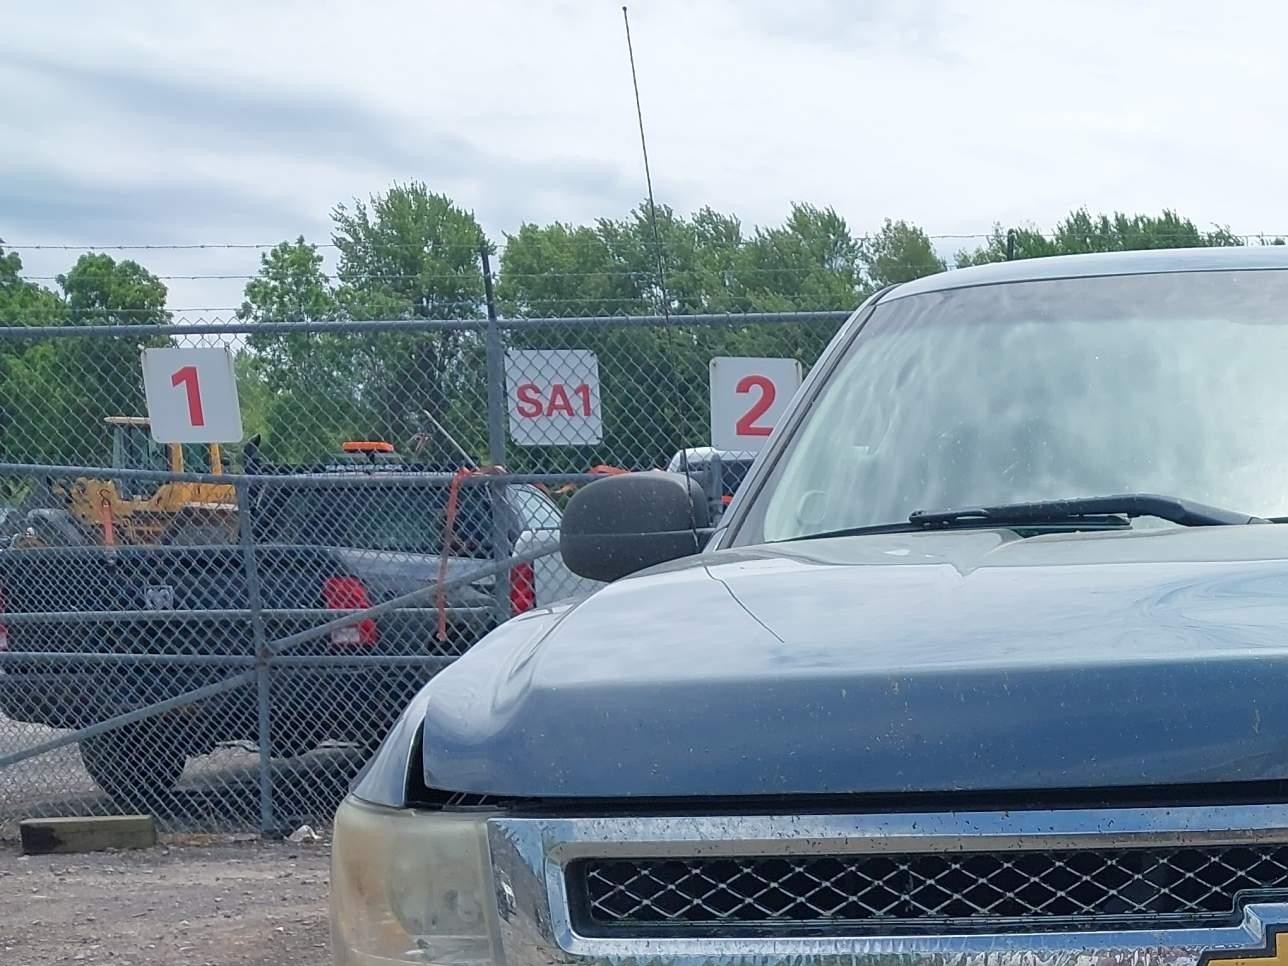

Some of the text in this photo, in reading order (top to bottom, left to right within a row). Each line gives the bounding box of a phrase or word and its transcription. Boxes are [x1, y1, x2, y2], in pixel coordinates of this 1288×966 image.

[171, 366, 205, 427] 1
[516, 383, 592, 418] SA1
[735, 375, 777, 436] 2
